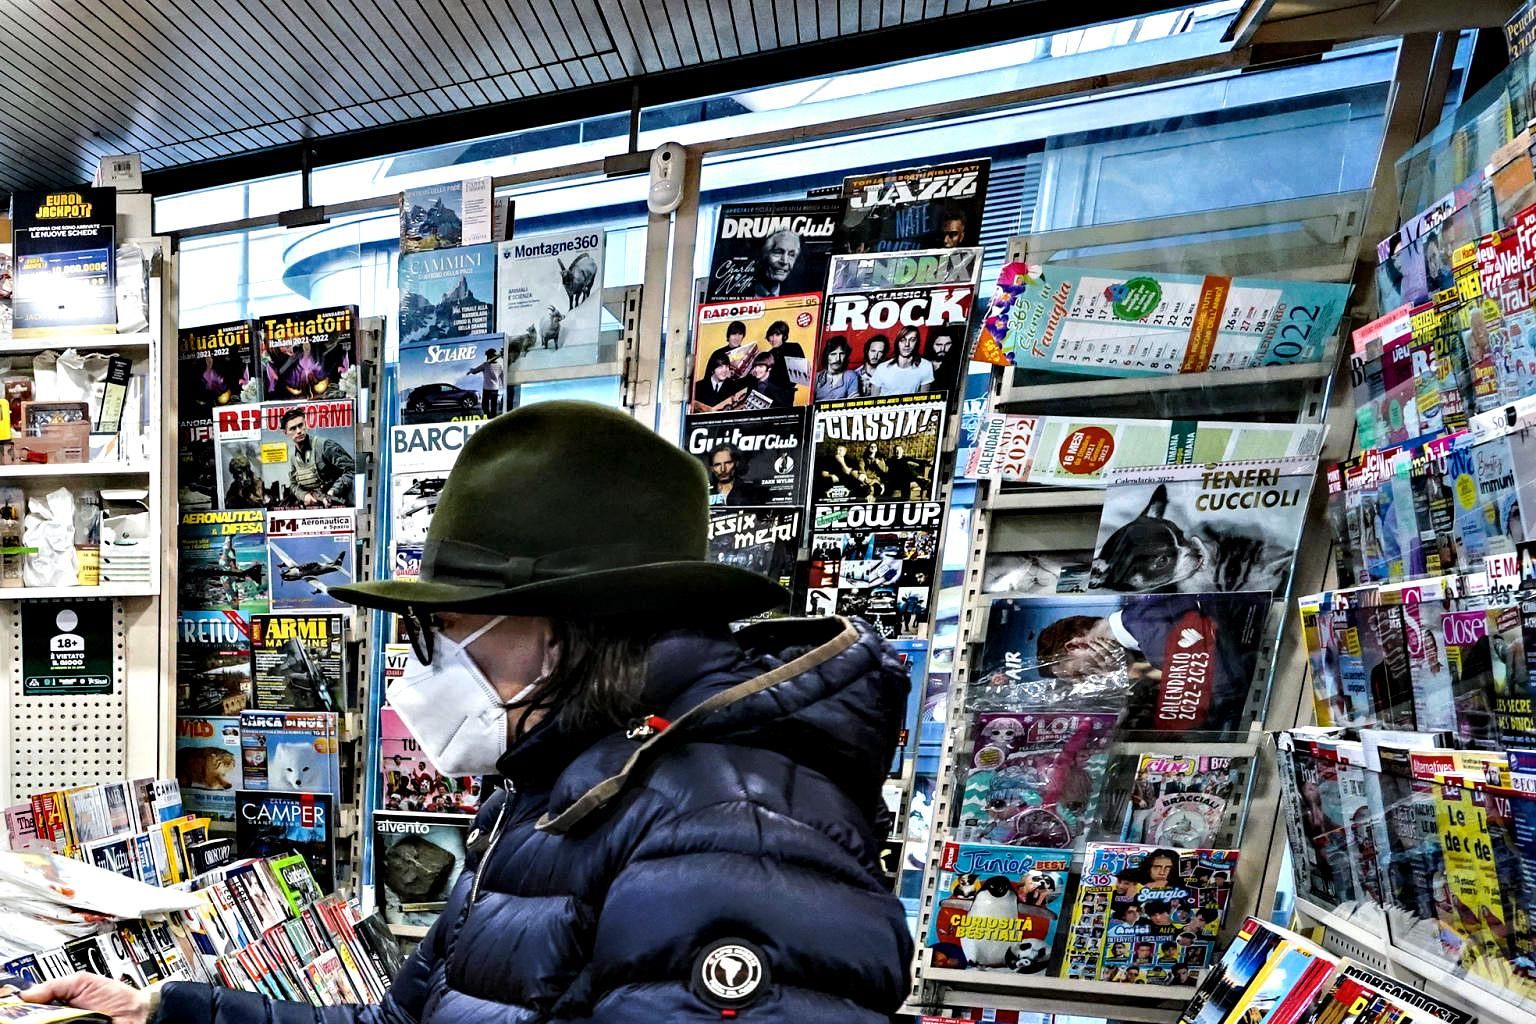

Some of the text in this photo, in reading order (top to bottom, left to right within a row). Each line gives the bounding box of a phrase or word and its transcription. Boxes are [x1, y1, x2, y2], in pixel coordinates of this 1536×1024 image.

[850, 171, 978, 208] JAZZ
[515, 235, 598, 259] Montagne360
[265, 310, 350, 340] Tatuatori
[978, 418, 1005, 474] CALENDARIO
[1004, 419, 1036, 475] 2022
[1202, 467, 1281, 491] TENERI
[1196, 488, 1300, 512] CUCCIOLI
[182, 511, 264, 525] AERONAUTICA
[221, 523, 264, 535] DIFESA
[266, 618, 328, 640] ARMI
[1160, 653, 1191, 720] CALENDARIO
[242, 803, 324, 824] CAMPER
[377, 820, 430, 834] alvento
[1138, 888, 1188, 903] Sangio
[950, 914, 1033, 932] CURIOSITÀ
[954, 927, 1024, 942] BESTIALI
